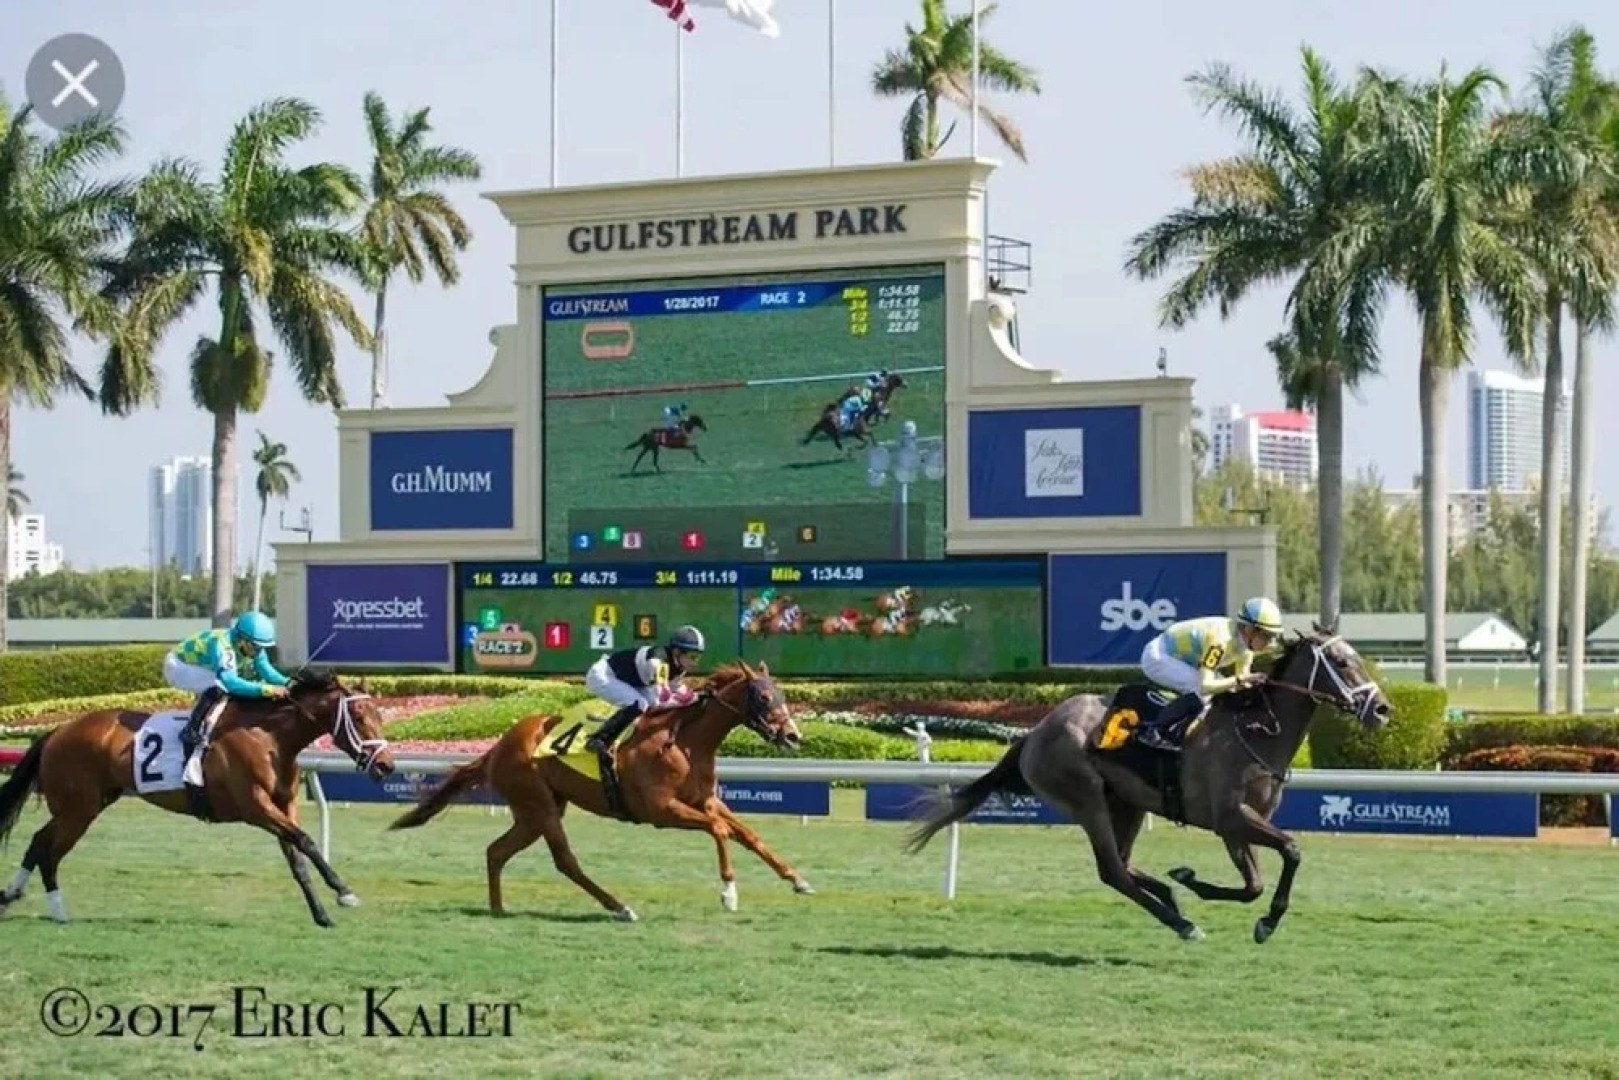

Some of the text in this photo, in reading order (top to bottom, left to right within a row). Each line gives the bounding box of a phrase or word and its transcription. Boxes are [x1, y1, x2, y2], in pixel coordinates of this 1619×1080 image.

[567, 204, 907, 254] GULFSTREAM PARK
[663, 296, 720, 310] 1/28/2017
[760, 291, 806, 305] RACE 2
[549, 299, 629, 316] GULFSTREAM
[580, 535, 589, 548] 3
[688, 534, 697, 547] 1
[749, 534, 757, 545] 2
[473, 567, 864, 586] 1/4 22.68 1/2 46.75 3/4 1:11.19 Mile 1:34.58
[332, 596, 423, 622] xpressbet
[1100, 580, 1178, 631] sbe
[487, 610, 496, 628] 5
[600, 607, 611, 624] 4
[551, 628, 560, 646] 1
[640, 619, 650, 637] 6
[598, 629, 608, 646] 2
[224, 650, 235, 669] 2
[1205, 649, 1220, 667] 6
[658, 665, 666, 682] 4
[1100, 708, 1140, 749] 6
[551, 723, 584, 755] 4
[140, 733, 163, 783] 2
[1353, 802, 1450, 821] GULFSTREAM
